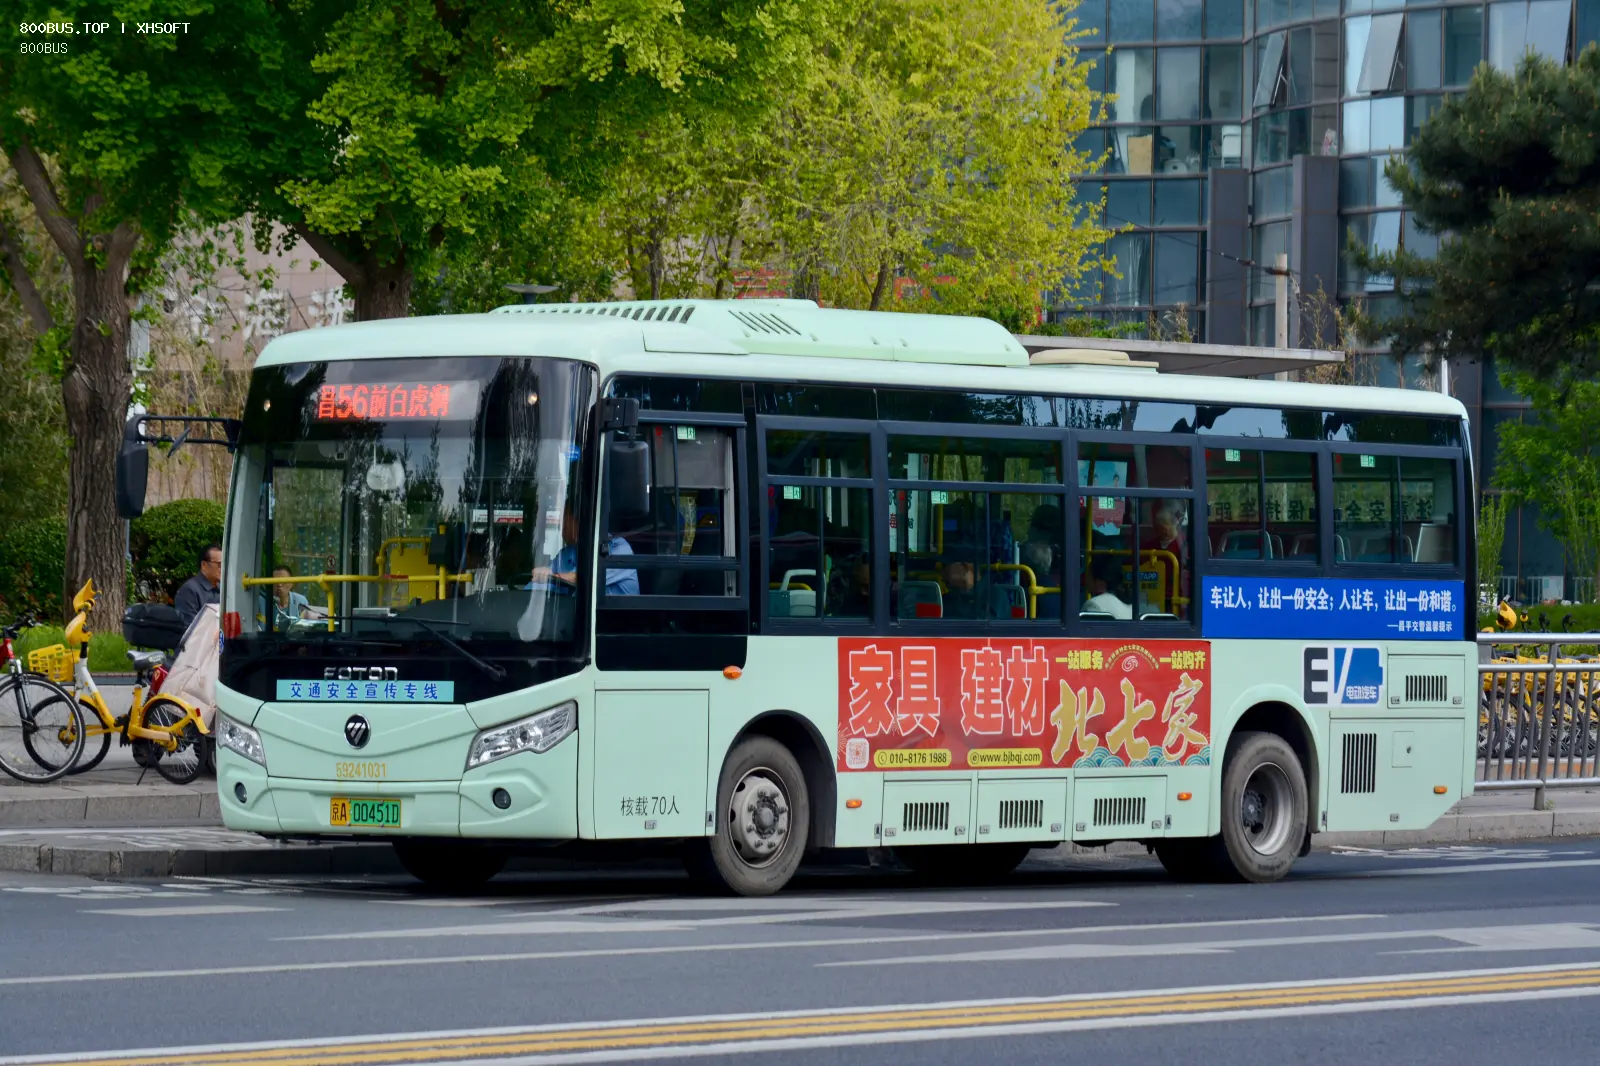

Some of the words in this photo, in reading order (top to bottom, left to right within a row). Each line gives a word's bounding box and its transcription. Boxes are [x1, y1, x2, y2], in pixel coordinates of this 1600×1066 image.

[1210, 585, 1457, 613] 车让人，让出一份安全；人让车，让出一份和谐。
[1055, 649, 1104, 670] 一站服务
[1159, 649, 1207, 670] 一站购齐
[323, 666, 399, 682] FOTON
[290, 682, 438, 700] 交通安全宣传专线
[849, 643, 941, 738] 家具
[960, 646, 1050, 737] 建材
[1345, 685, 1378, 700] 电动汽车
[1050, 672, 1209, 765] 北七家
[889, 752, 928, 764] 010-8176
[929, 751, 948, 764] 1988
[979, 750, 1041, 765] www.bjbqj.com
[335, 762, 388, 779] 59241031
